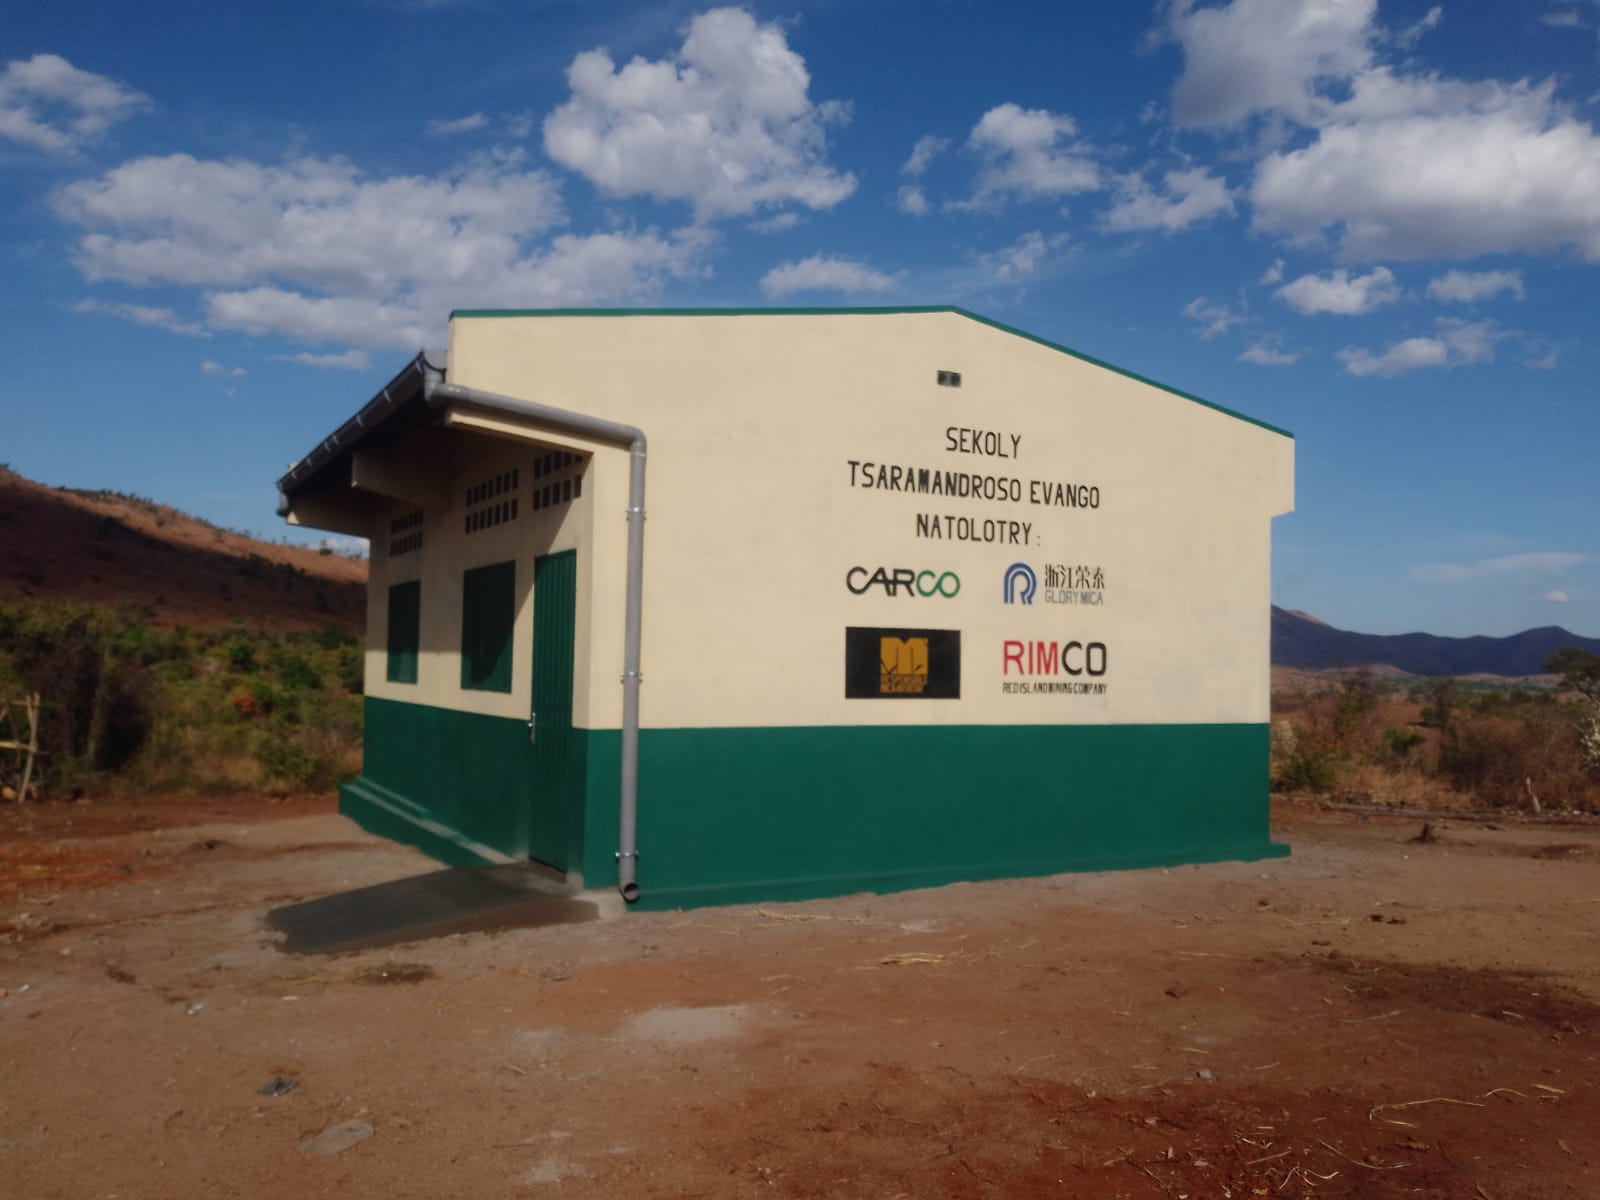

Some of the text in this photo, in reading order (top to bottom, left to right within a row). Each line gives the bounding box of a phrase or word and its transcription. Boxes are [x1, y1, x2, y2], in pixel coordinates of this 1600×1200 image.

[946, 426, 1021, 459] SEKOLY
[847, 460, 1100, 509] TSARAMANDROSO EVANGO
[846, 566, 961, 599] CARCO
[1044, 589, 1104, 606] GLORY MICA
[1003, 640, 1107, 677] RIMCO
[1002, 682, 1018, 694] RED
[1019, 682, 1048, 694] ISLAND
[1073, 682, 1108, 695] COMPANY
